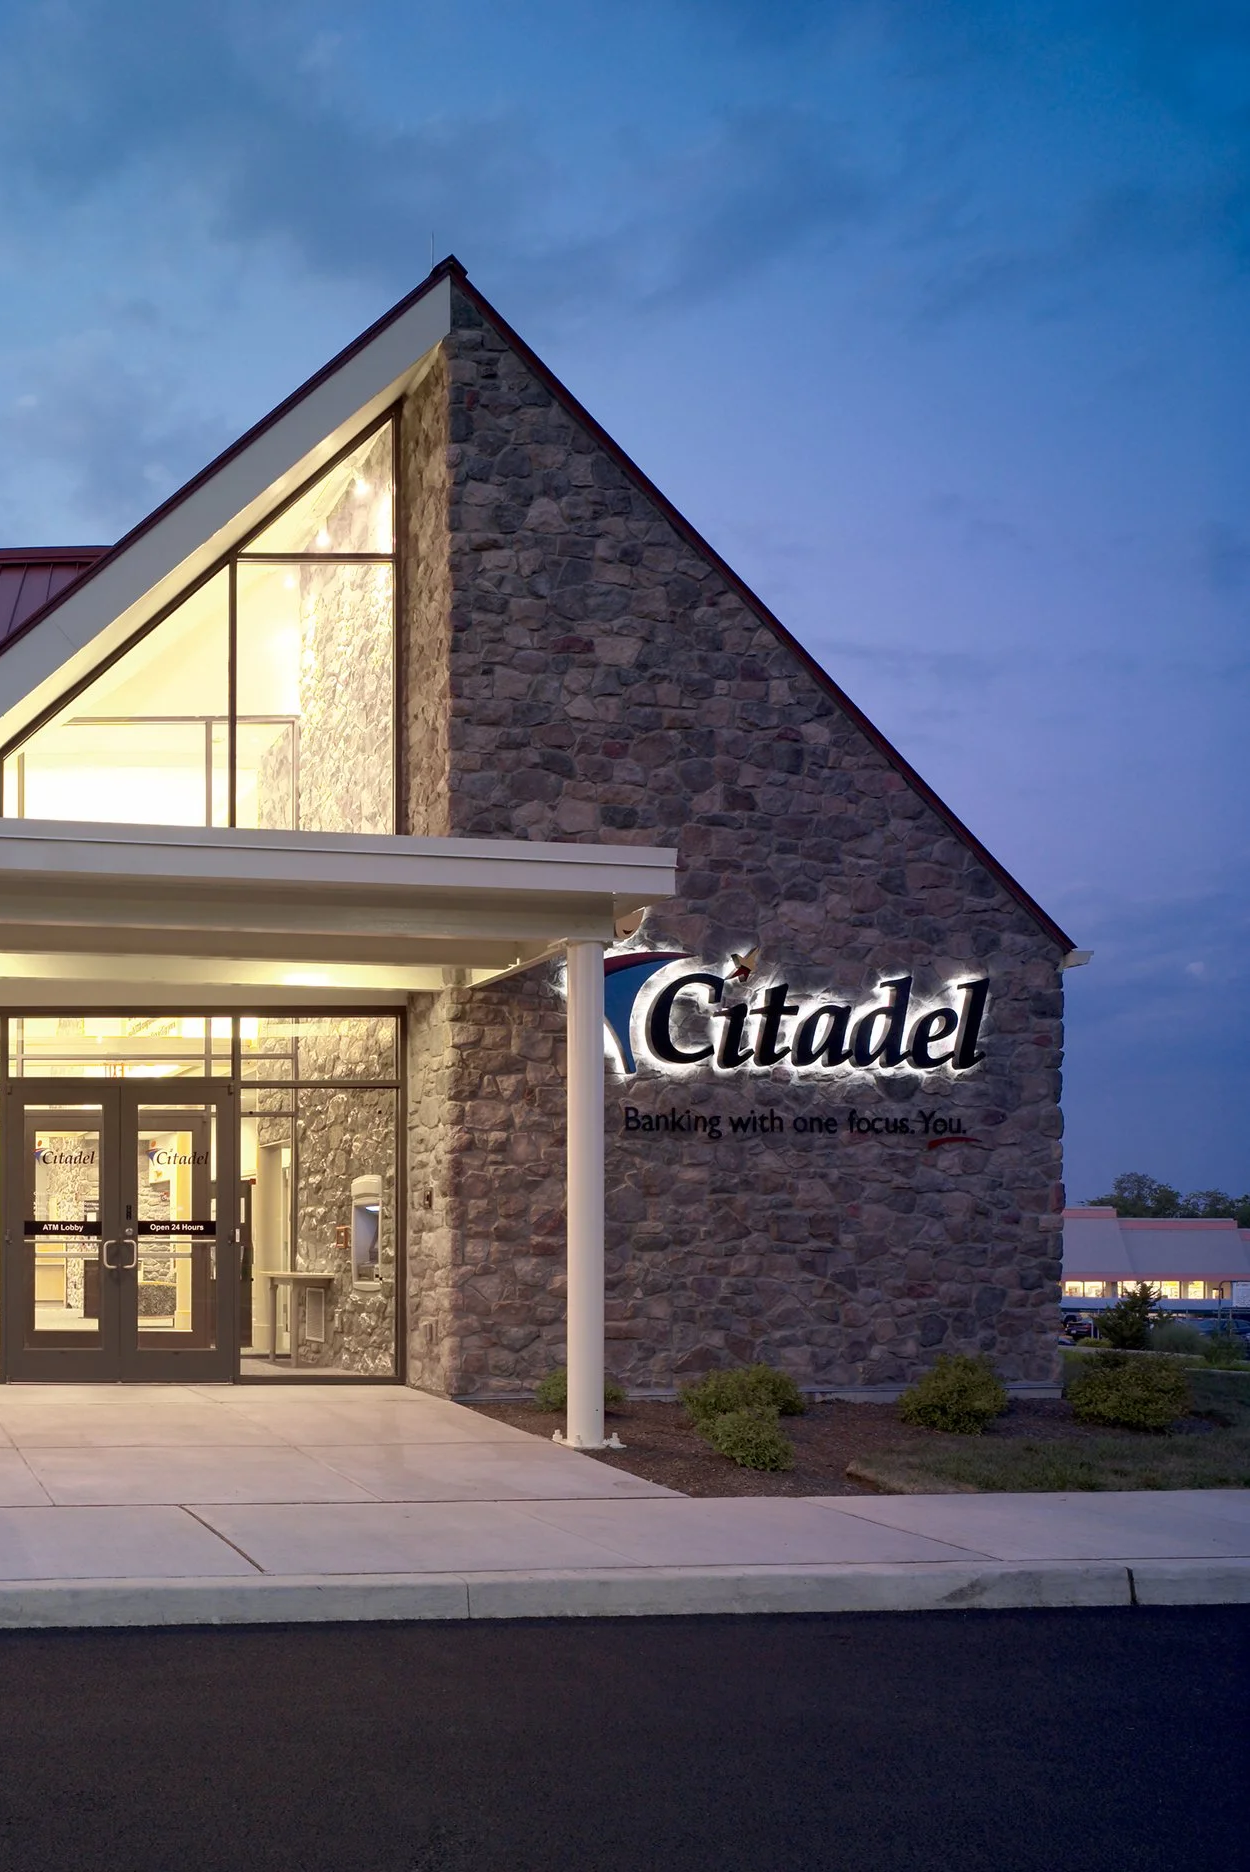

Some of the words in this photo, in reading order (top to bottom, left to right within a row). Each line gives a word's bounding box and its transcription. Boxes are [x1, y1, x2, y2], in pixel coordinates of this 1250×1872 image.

[645, 968, 990, 1070] Citadel
[623, 1106, 722, 1138] Banking
[729, 1108, 784, 1133] with
[792, 1112, 839, 1134] one
[848, 1109, 916, 1134] focus.
[918, 1110, 967, 1134] You.
[42, 1150, 95, 1165] Citadel
[156, 1150, 209, 1165] Citadel
[42, 1223, 59, 1231] ATM
[61, 1223, 84, 1232] Lobby
[150, 1223, 170, 1232] Open
[171, 1223, 180, 1231] 24
[182, 1223, 204, 1231] Hours
